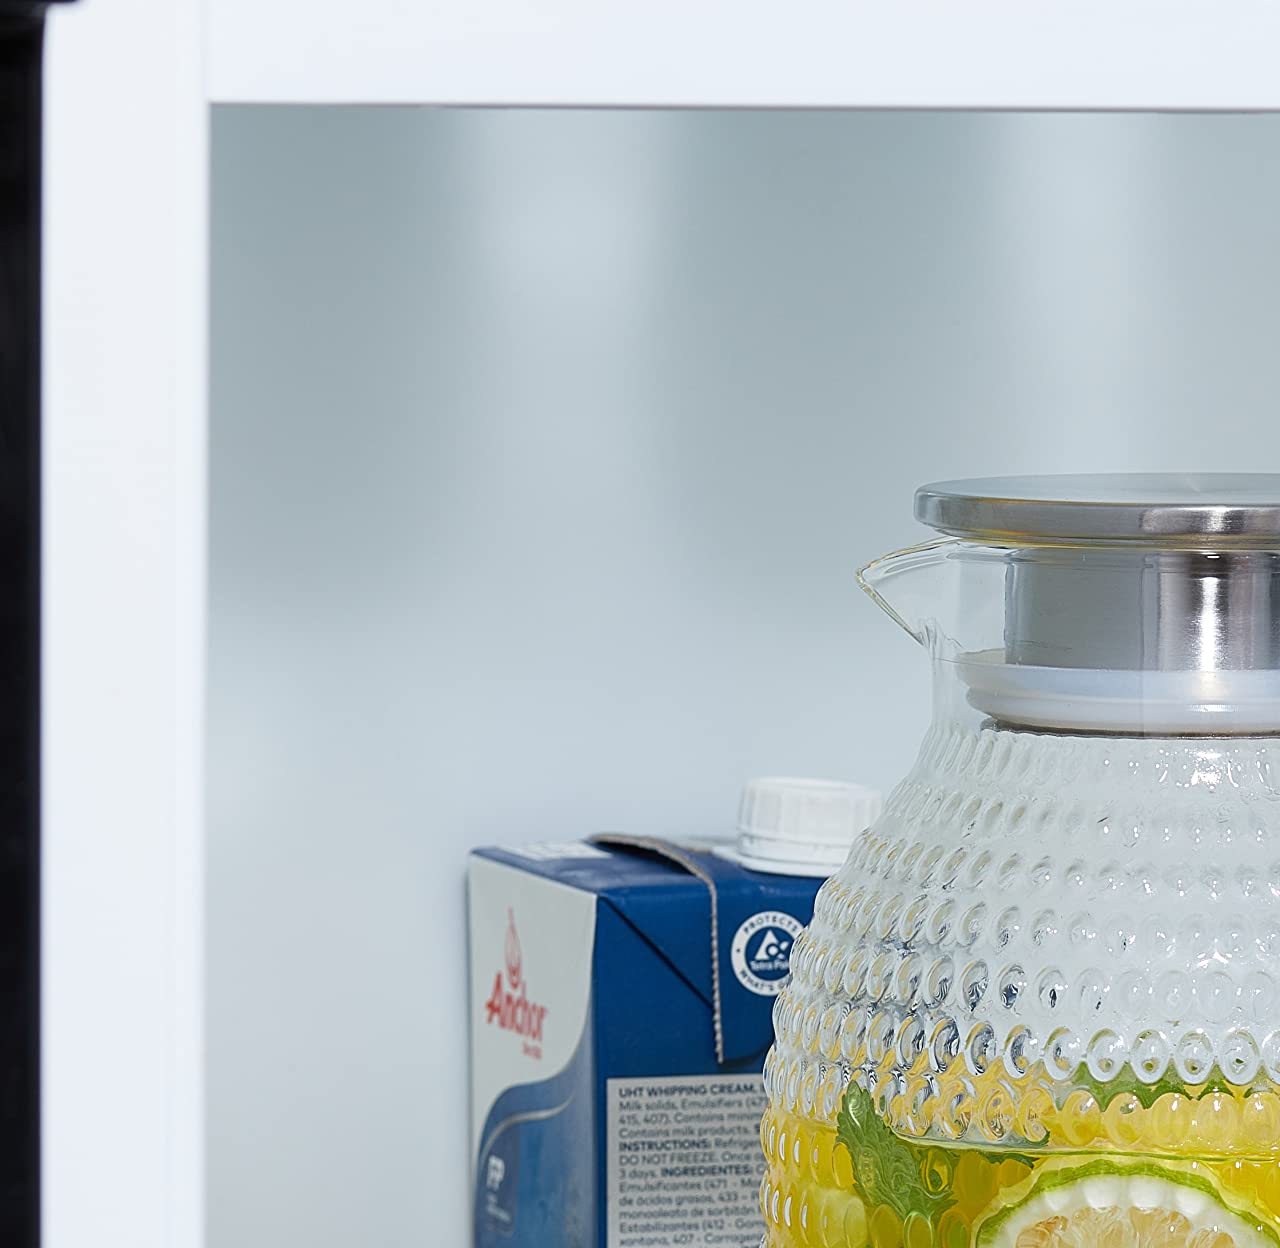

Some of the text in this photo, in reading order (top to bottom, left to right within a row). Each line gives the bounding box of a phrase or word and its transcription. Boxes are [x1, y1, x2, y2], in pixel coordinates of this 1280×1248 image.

[743, 915, 798, 934] PROTECTS
[485, 970, 548, 1042] Anchor
[619, 1087, 643, 1098] UHT
[647, 1085, 706, 1097] WHIPPING
[619, 1100, 642, 1111] Milk
[681, 1097, 742, 1109] Emulsifiers
[674, 1111, 724, 1123] Contains
[619, 1127, 669, 1139] Contains
[672, 1125, 694, 1136] milk
[619, 1154, 639, 1166] DO
[642, 1153, 667, 1165] NOT
[721, 1151, 750, 1162] Once
[619, 1180, 701, 1193] Emulsificantes
[619, 1196, 633, 1206] de
[691, 1206, 704, 1217] de
[620, 1221, 700, 1233] Estabilizantes
[673, 1233, 694, 1245] 407
